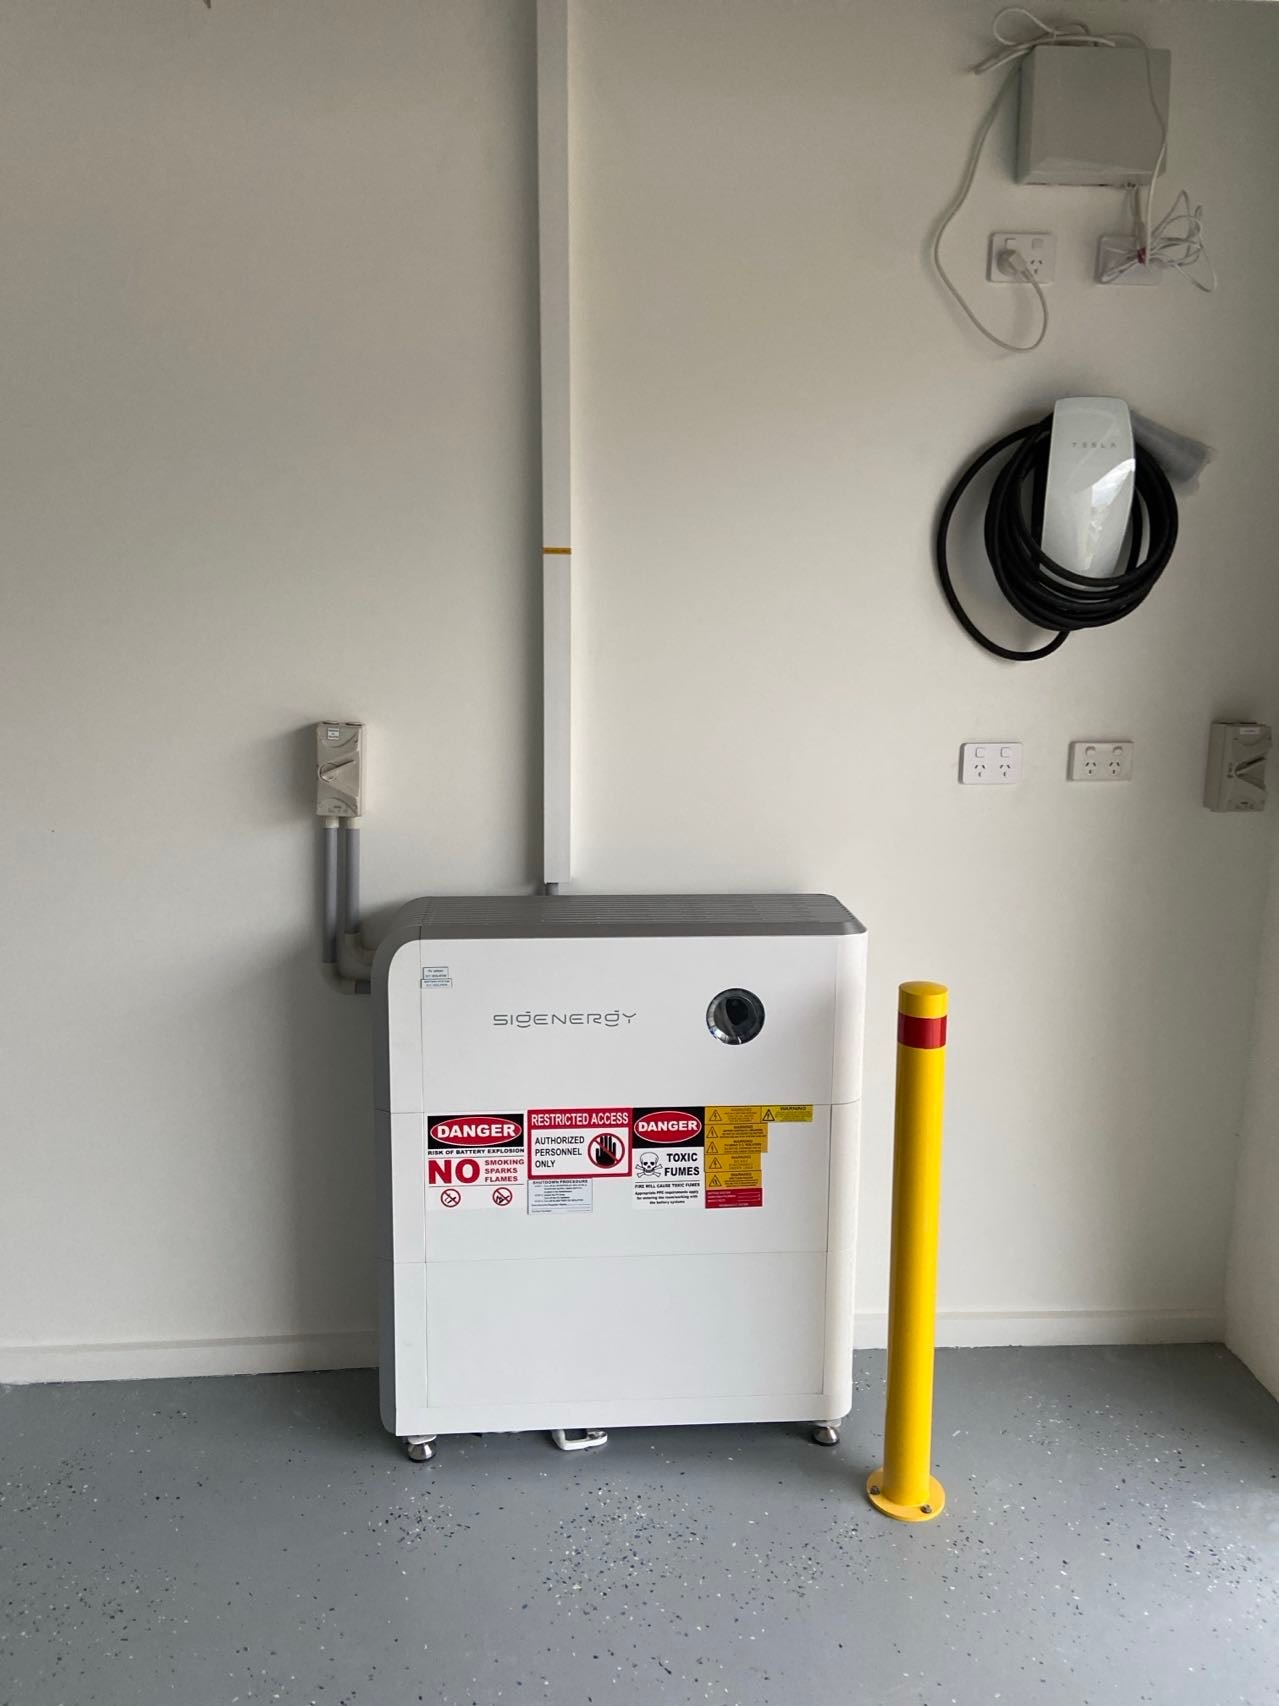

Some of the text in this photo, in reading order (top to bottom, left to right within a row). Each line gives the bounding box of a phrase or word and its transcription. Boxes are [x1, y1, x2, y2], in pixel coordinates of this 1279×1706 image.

[531, 1112, 629, 1126] RESTRICTED ACCESS
[437, 1124, 516, 1138] DANGER
[638, 1121, 698, 1132] DANGER
[535, 1136, 585, 1145] AUTHORIZED
[535, 1148, 582, 1156] PERSONNEL
[666, 1153, 698, 1162] TOXIC
[535, 1160, 556, 1168] ONLY
[428, 1158, 480, 1184] NO
[664, 1166, 700, 1176] FUMES
